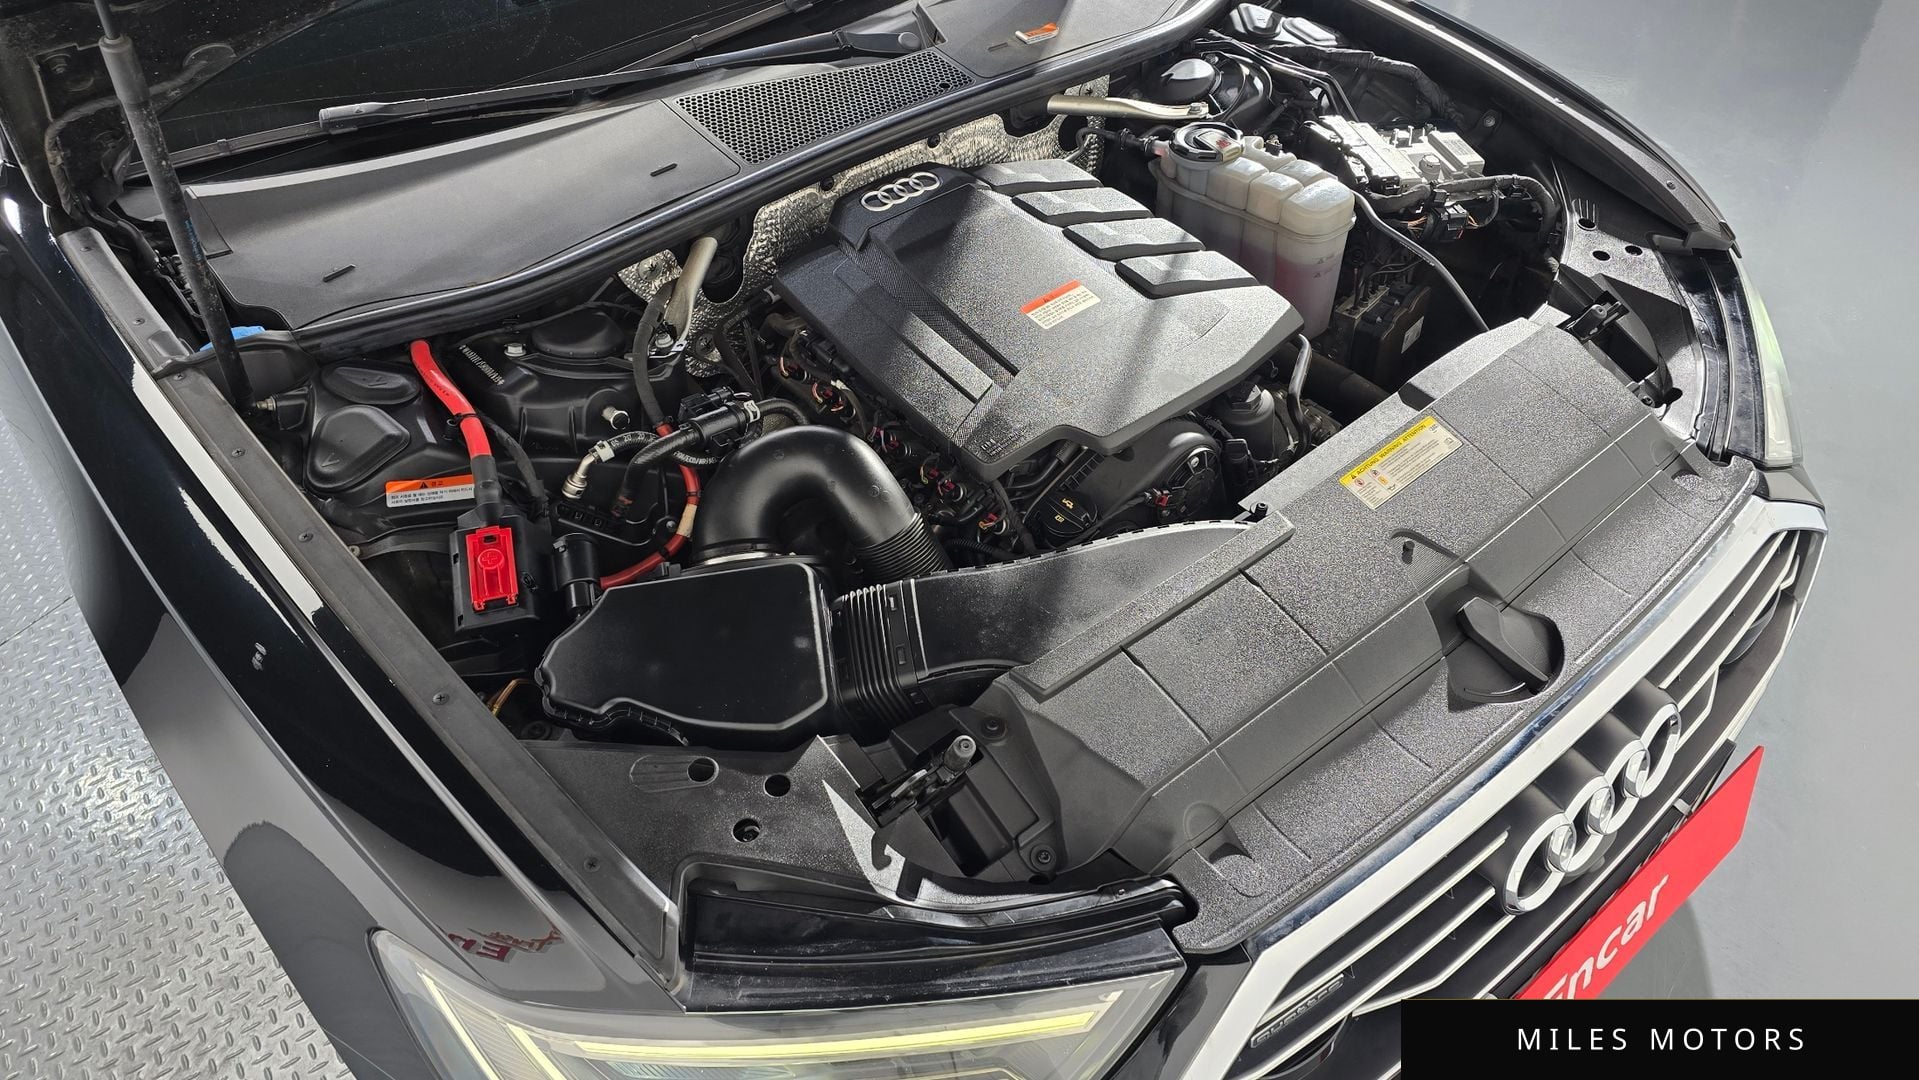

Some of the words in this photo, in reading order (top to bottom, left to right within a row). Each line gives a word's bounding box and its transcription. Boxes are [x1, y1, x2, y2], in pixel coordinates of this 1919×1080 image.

[1380, 441, 1402, 458] WARNING
[1403, 424, 1426, 442] ATTENTION
[1256, 980, 1343, 1045] quattro
